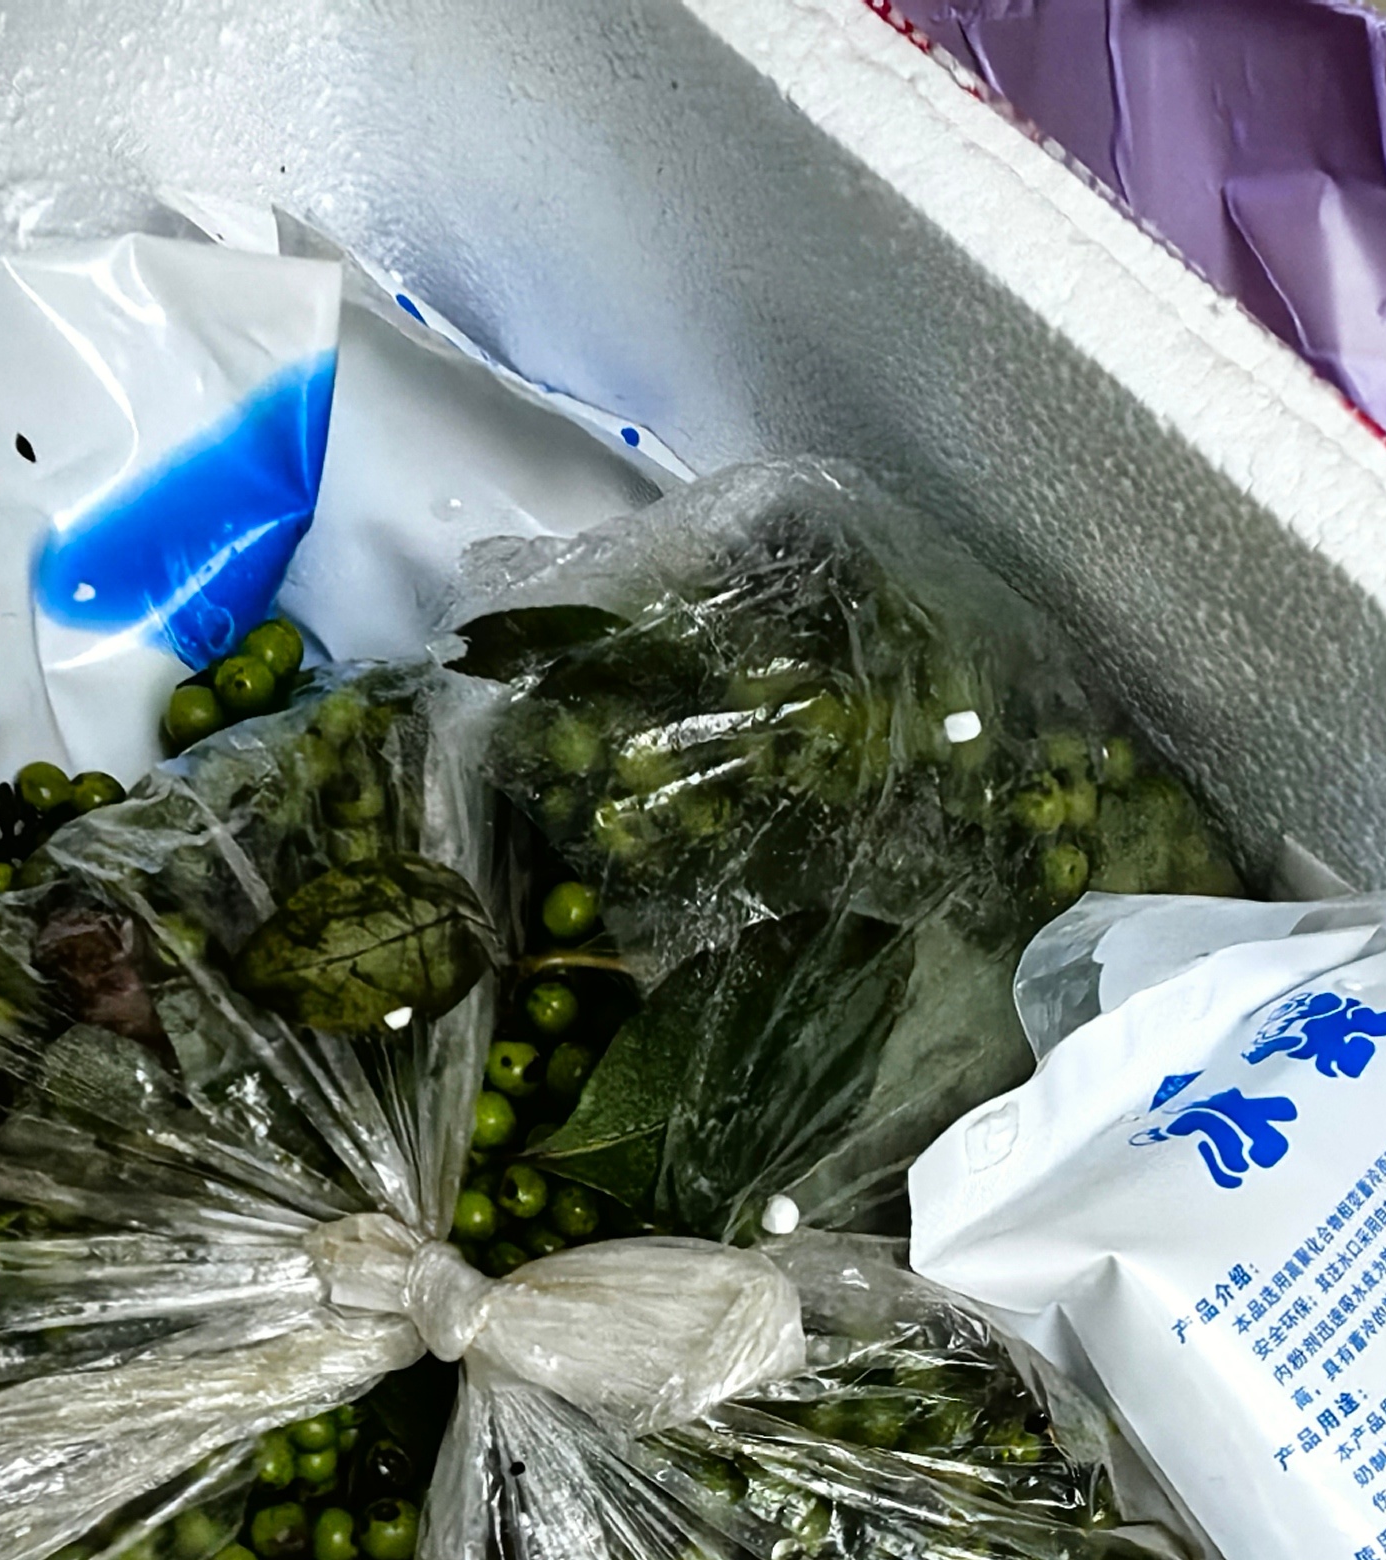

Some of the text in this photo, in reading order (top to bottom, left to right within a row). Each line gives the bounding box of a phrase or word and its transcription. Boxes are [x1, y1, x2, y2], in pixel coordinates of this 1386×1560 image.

[1170, 1262, 1260, 1344] 产品介绍：
[1273, 1387, 1368, 1471] 产品用途：
